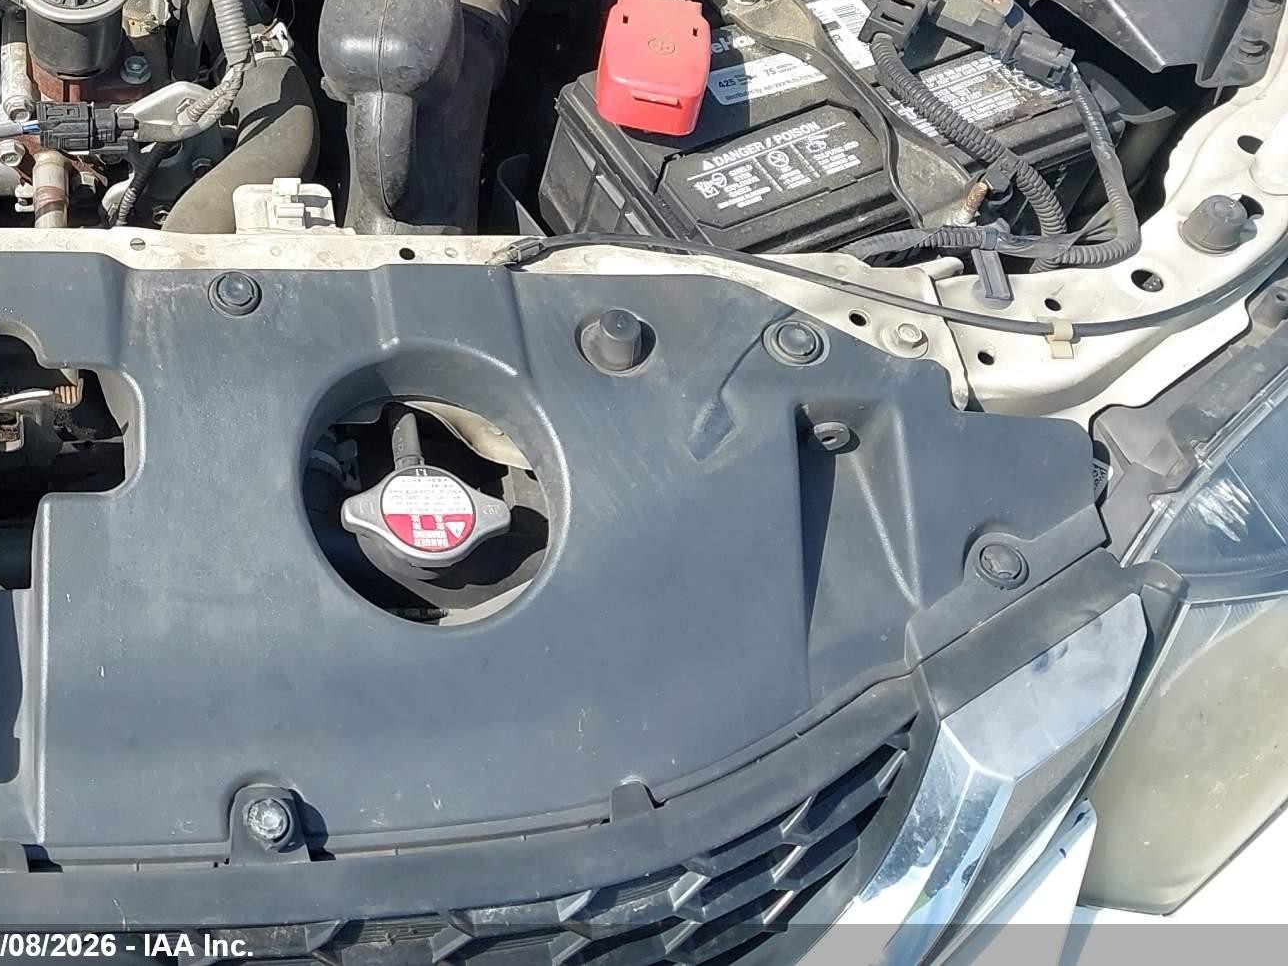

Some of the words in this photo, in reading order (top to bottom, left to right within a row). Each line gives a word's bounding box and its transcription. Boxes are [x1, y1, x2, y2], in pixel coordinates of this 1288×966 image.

[718, 76, 737, 88] 425
[713, 141, 765, 167] DANGER
[771, 121, 821, 145] POISON
